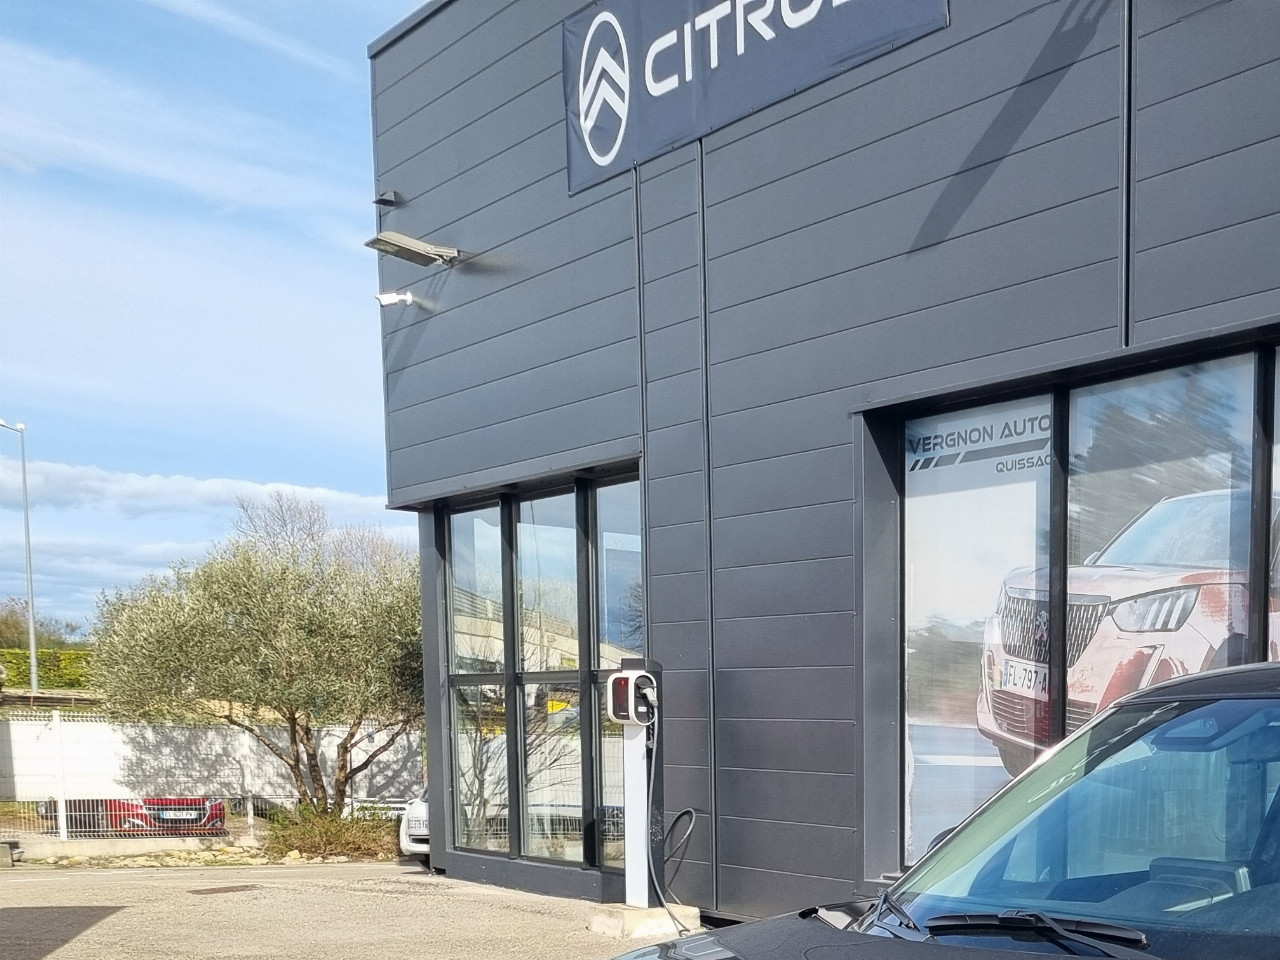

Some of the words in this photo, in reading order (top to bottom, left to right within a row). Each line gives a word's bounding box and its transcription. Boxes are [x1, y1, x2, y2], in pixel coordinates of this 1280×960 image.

[645, 0, 849, 96] CITRO
[909, 424, 994, 454] VERGNON
[1000, 414, 1051, 440] AUTO
